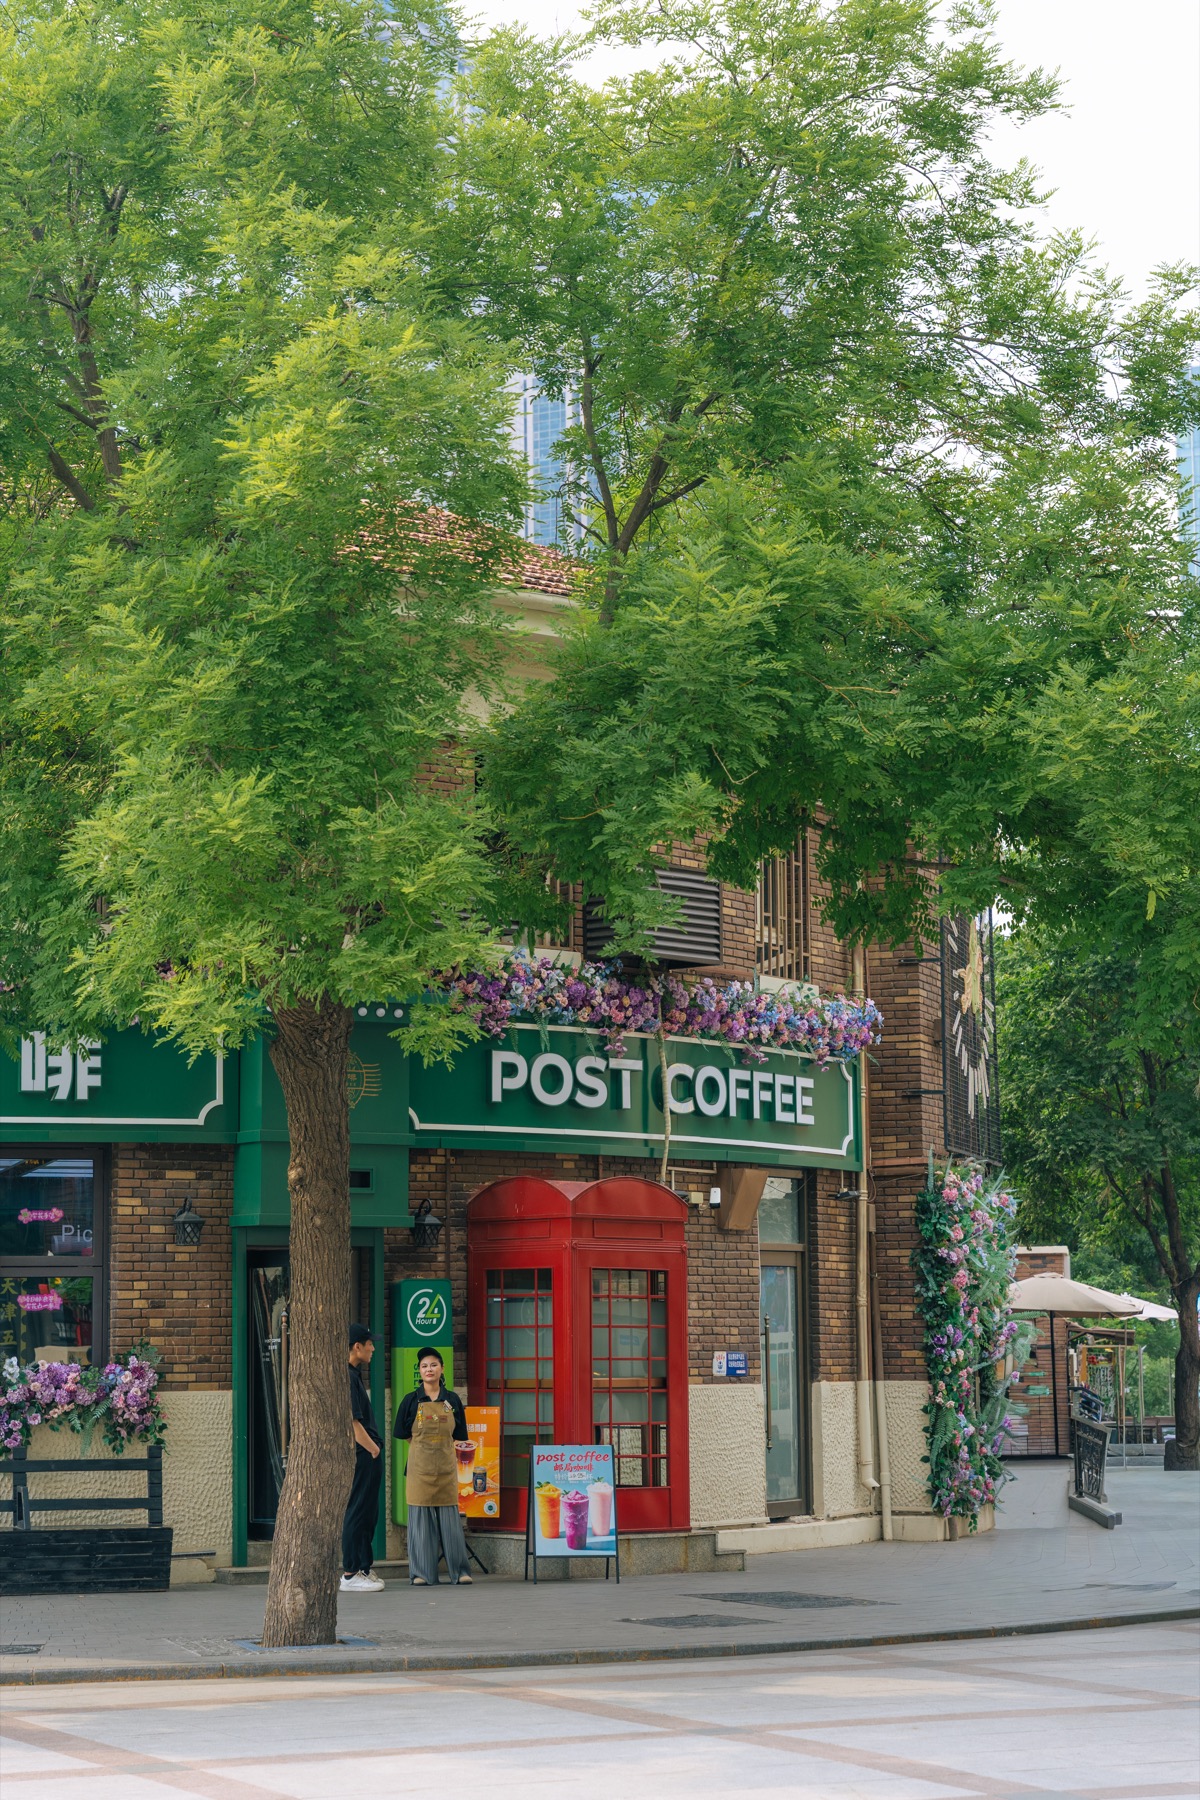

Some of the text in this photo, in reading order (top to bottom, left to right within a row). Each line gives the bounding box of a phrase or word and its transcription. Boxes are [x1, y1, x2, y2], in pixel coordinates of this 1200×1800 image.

[21, 1031, 102, 1100] 啡
[491, 1050, 815, 1125] POST COFFEE
[62, 1224, 93, 1243] Pic
[417, 1294, 441, 1325] 24
[536, 1450, 610, 1465] post coffee
[553, 1463, 594, 1472] 邮局咖啡
